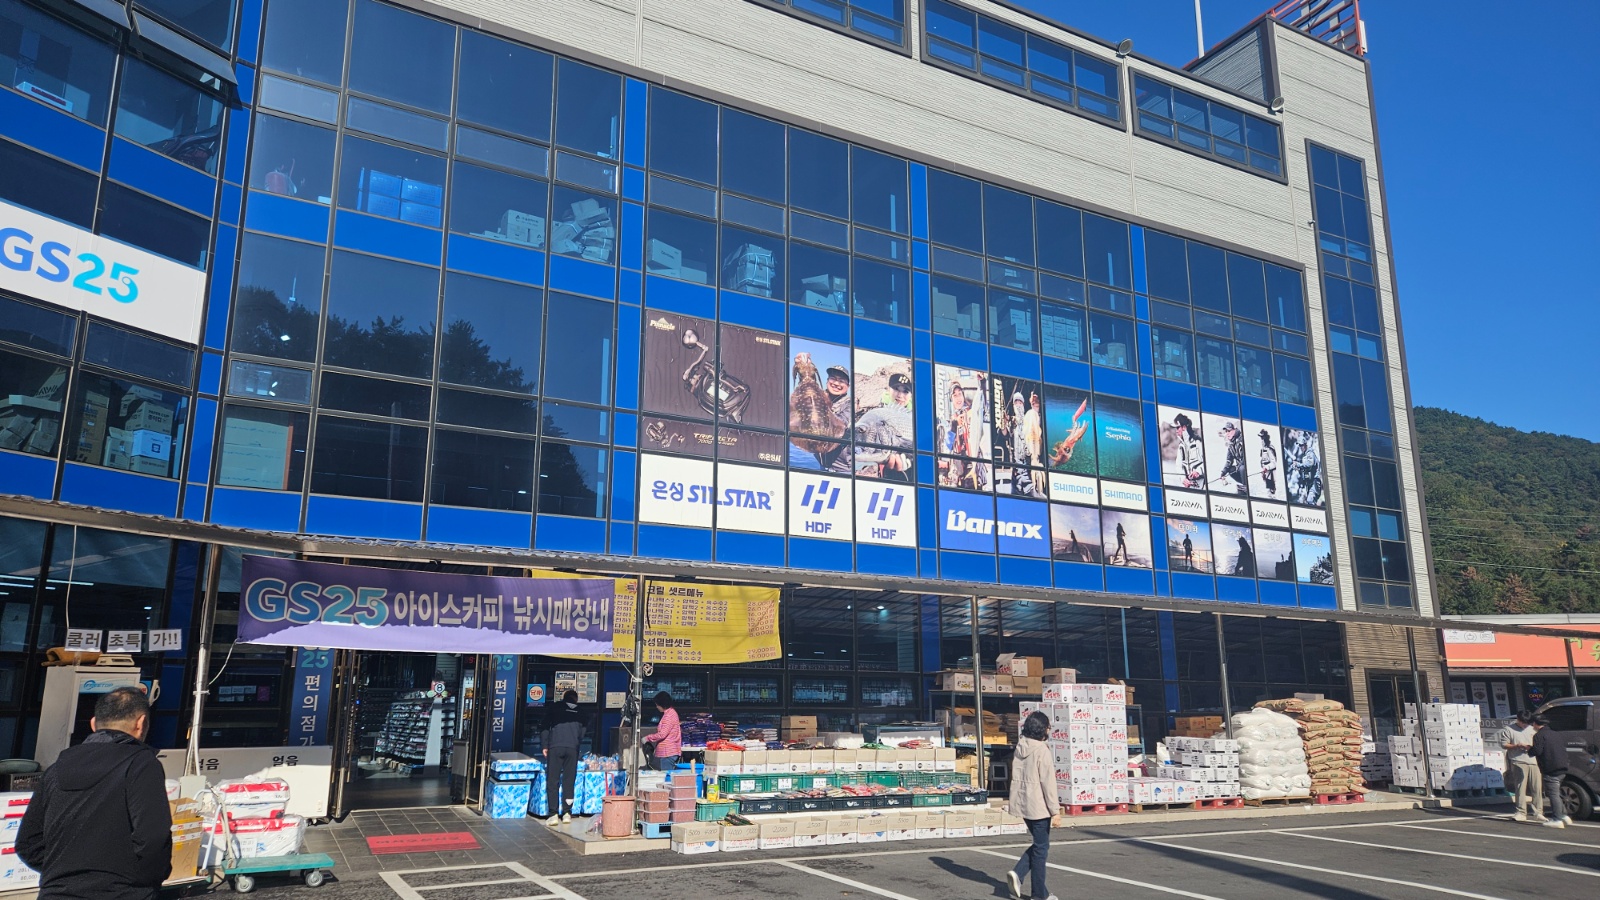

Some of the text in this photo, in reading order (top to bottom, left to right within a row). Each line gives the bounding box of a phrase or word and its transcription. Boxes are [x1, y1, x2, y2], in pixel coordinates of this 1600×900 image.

[0, 227, 139, 304] GS25
[994, 378, 1003, 429] Banax
[1105, 431, 1132, 442] Sephia
[652, 480, 772, 511] 은성 SILSTAR
[1053, 482, 1094, 495] SHIMANO
[1104, 489, 1144, 502] SHIMANO
[805, 520, 832, 535] HDF
[946, 509, 1043, 540] Banax
[1178, 523, 1199, 534] 다이와
[872, 527, 897, 540] HDF
[245, 577, 610, 632] GS25 아이스커피 낚시매장내
[67, 632, 178, 648] 쿨러 초특 가!!
[301, 651, 329, 669] 25
[492, 655, 514, 670] 25
[272, 755, 299, 767] 얼음
